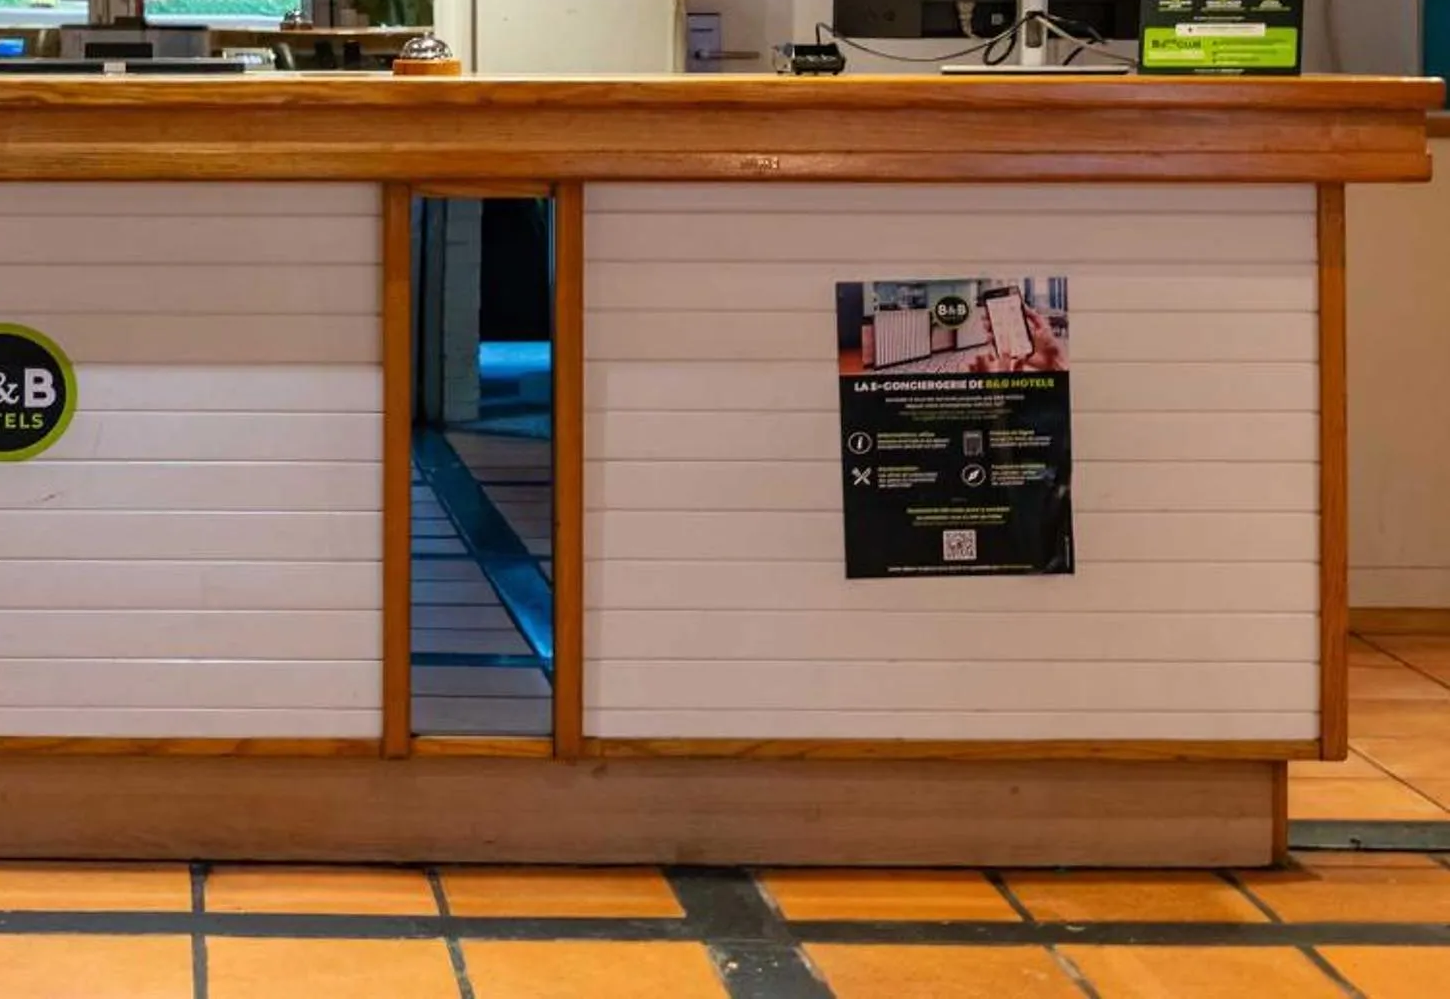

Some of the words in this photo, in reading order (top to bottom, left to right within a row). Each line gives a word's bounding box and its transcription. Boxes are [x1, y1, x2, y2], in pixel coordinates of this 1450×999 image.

[937, 304, 967, 316] B&B
[854, 381, 869, 392] LA
[871, 379, 968, 392] E-CONCIERGERIE
[968, 379, 984, 390] DE
[1011, 378, 1055, 389] HOTELS
